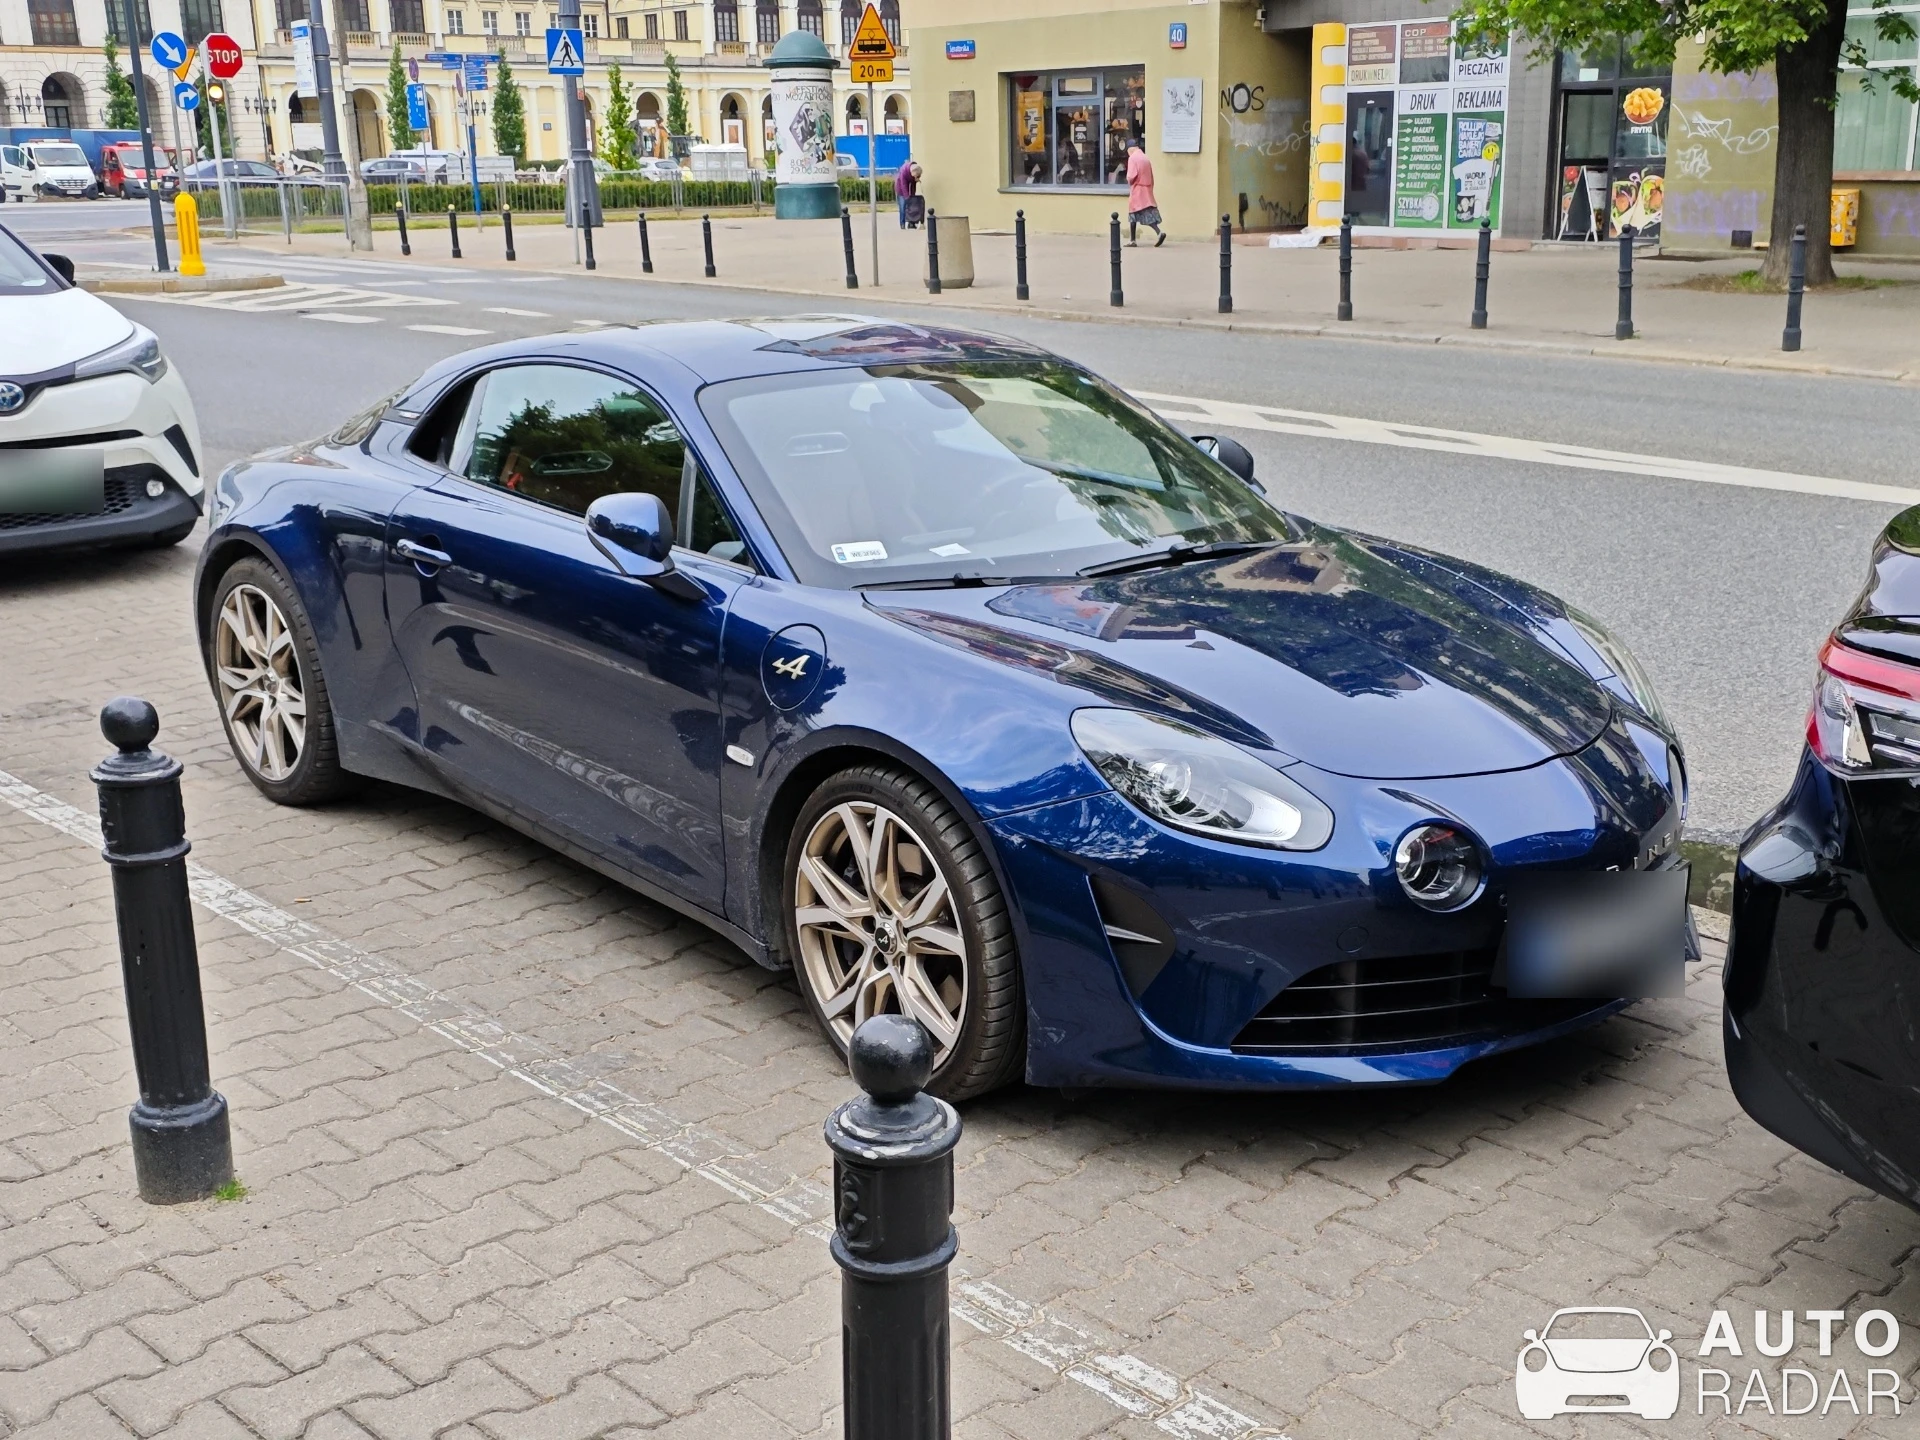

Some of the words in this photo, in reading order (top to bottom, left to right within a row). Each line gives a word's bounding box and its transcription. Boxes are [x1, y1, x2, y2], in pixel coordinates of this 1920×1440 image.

[1171, 28, 1183, 42] 40
[208, 49, 239, 64] STOP
[859, 64, 875, 78] 20
[876, 68, 887, 78] m
[1458, 62, 1504, 77] PIECZĄTKI
[795, 85, 830, 94] FESTIWA
[1220, 82, 1265, 114] NOS
[1410, 93, 1437, 111] DRUK
[1457, 90, 1502, 109] REKLAMA
[1630, 126, 1653, 134] FRYTKI
